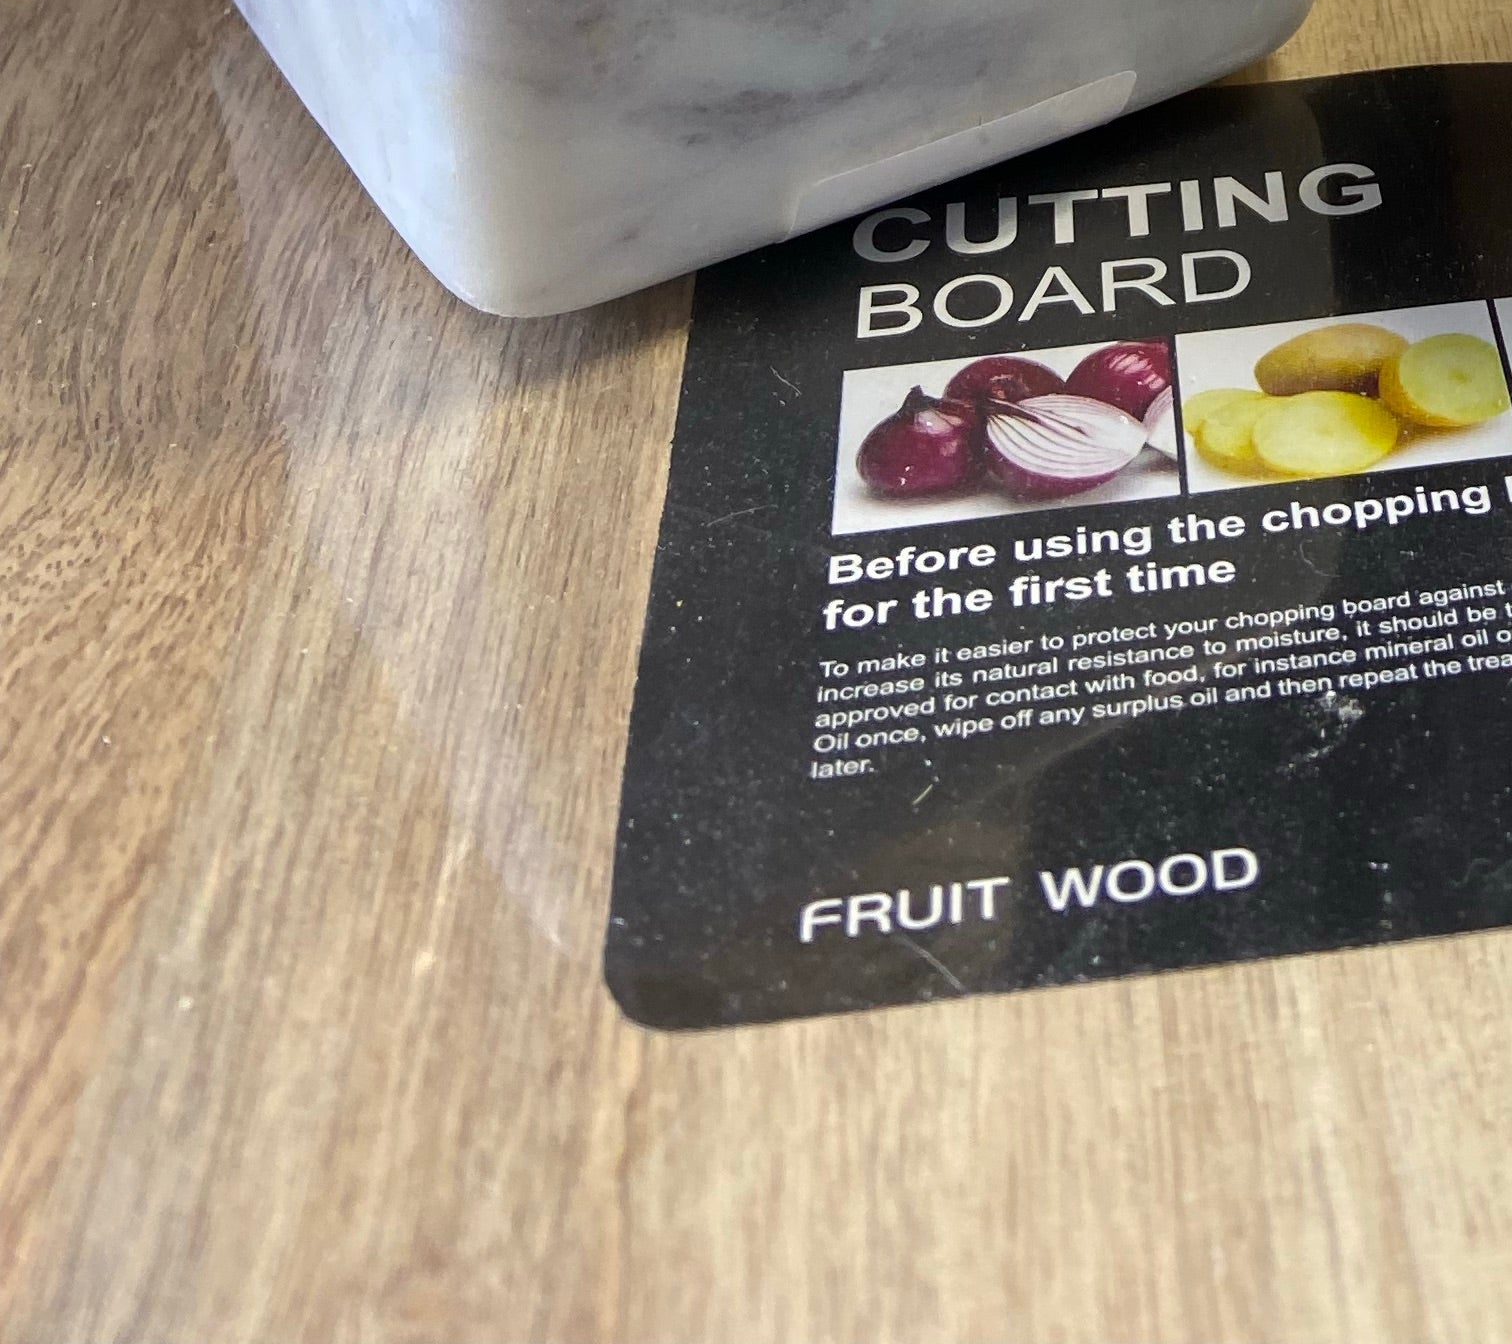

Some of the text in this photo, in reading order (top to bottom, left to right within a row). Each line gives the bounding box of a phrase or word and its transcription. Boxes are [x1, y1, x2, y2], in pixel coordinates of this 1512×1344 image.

[852, 164, 1382, 262] CUTTING
[857, 250, 1251, 339] BOARD
[828, 544, 996, 584] Before
[1015, 526, 1152, 561] using
[1167, 514, 1245, 544] the
[1262, 485, 1491, 532] chopping
[820, 660, 849, 677] To
[858, 653, 926, 674] make
[935, 648, 949, 663] it
[956, 639, 1033, 660] easier
[1041, 635, 1064, 650] to
[1073, 623, 1157, 650] protect
[1164, 618, 1218, 640] your
[1225, 604, 1335, 629] chopping
[1342, 591, 1411, 619] board
[1419, 580, 1506, 607] against
[823, 561, 1236, 630] for the first time
[815, 697, 935, 729] approved
[944, 694, 978, 711] for
[986, 680, 1078, 706] contact
[1085, 673, 1135, 693] with
[1143, 665, 1205, 686] food,
[1213, 662, 1247, 678] for
[1255, 650, 1357, 674] instance
[1365, 633, 1454, 661] mineral
[1461, 628, 1489, 647] oil
[817, 678, 924, 702] increase
[935, 672, 963, 688] its
[973, 657, 1058, 683] natural
[1068, 645, 1194, 671] resistance
[1203, 640, 1226, 655] to
[1236, 628, 1347, 652] moisture,
[1356, 620, 1371, 637] it
[1379, 608, 1458, 639] should
[1466, 606, 1496, 622] be
[813, 732, 849, 752] Oil
[854, 728, 926, 748] once,
[934, 718, 994, 739] wipe
[1000, 709, 1033, 729] off
[1039, 707, 1085, 725] any
[1092, 694, 1184, 718] surplus
[1190, 687, 1218, 706] oil
[1225, 680, 1271, 702] and
[1277, 677, 1336, 698] then
[1339, 663, 1419, 690] repeat
[1423, 660, 1462, 677] the
[810, 759, 874, 778] later.
[800, 848, 1259, 942] FRUIT WOOD
